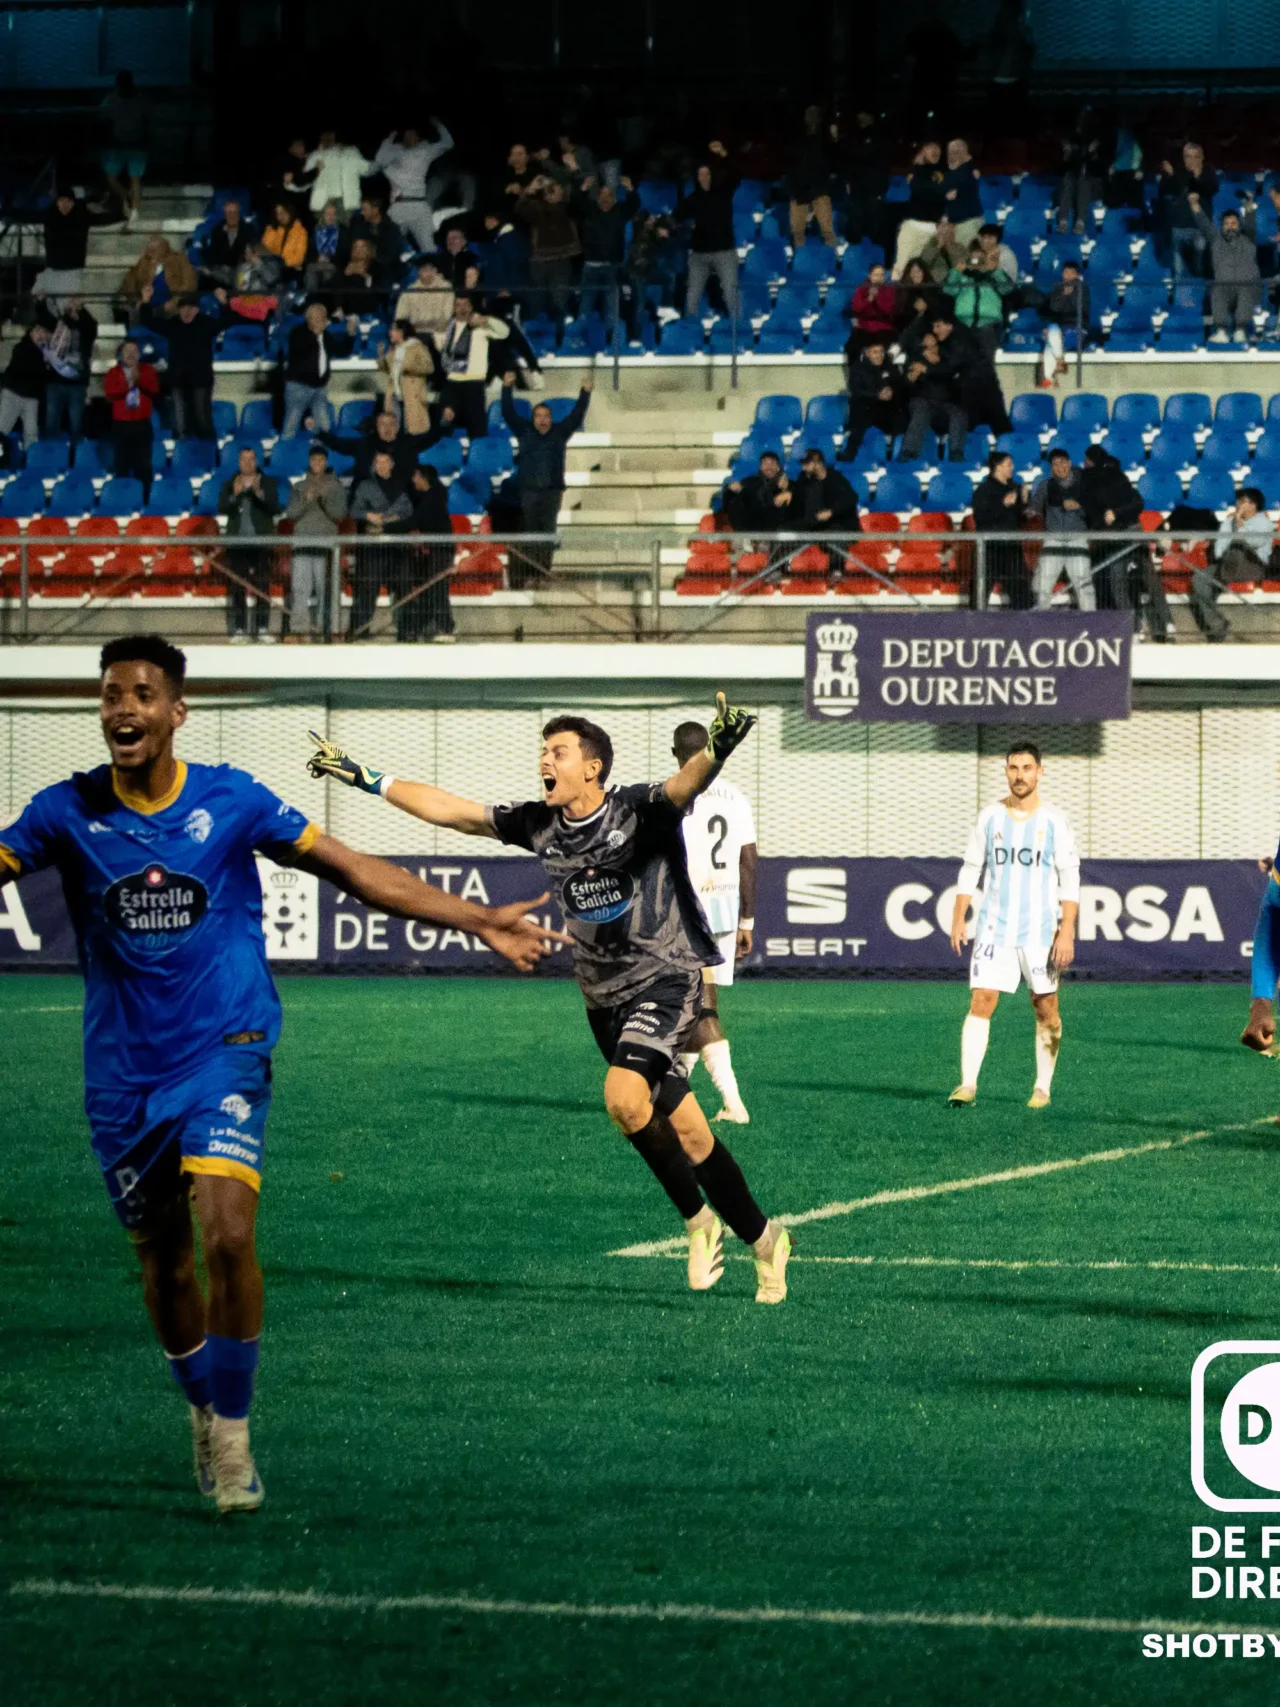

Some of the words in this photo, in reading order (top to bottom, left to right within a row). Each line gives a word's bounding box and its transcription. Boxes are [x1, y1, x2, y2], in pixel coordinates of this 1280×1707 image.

[882, 630, 1123, 668] DEPUTACIÓN
[880, 676, 1058, 706] OURENSE
[707, 814, 728, 870] 2
[995, 847, 1041, 867] DIGI
[570, 876, 620, 897] Estrella
[119, 888, 194, 908] Estrella
[576, 890, 622, 910] Galicia
[121, 908, 191, 930] Galicia
[885, 882, 1225, 942] CORSA
[334, 914, 390, 951] DE
[766, 938, 868, 957] SEAT
